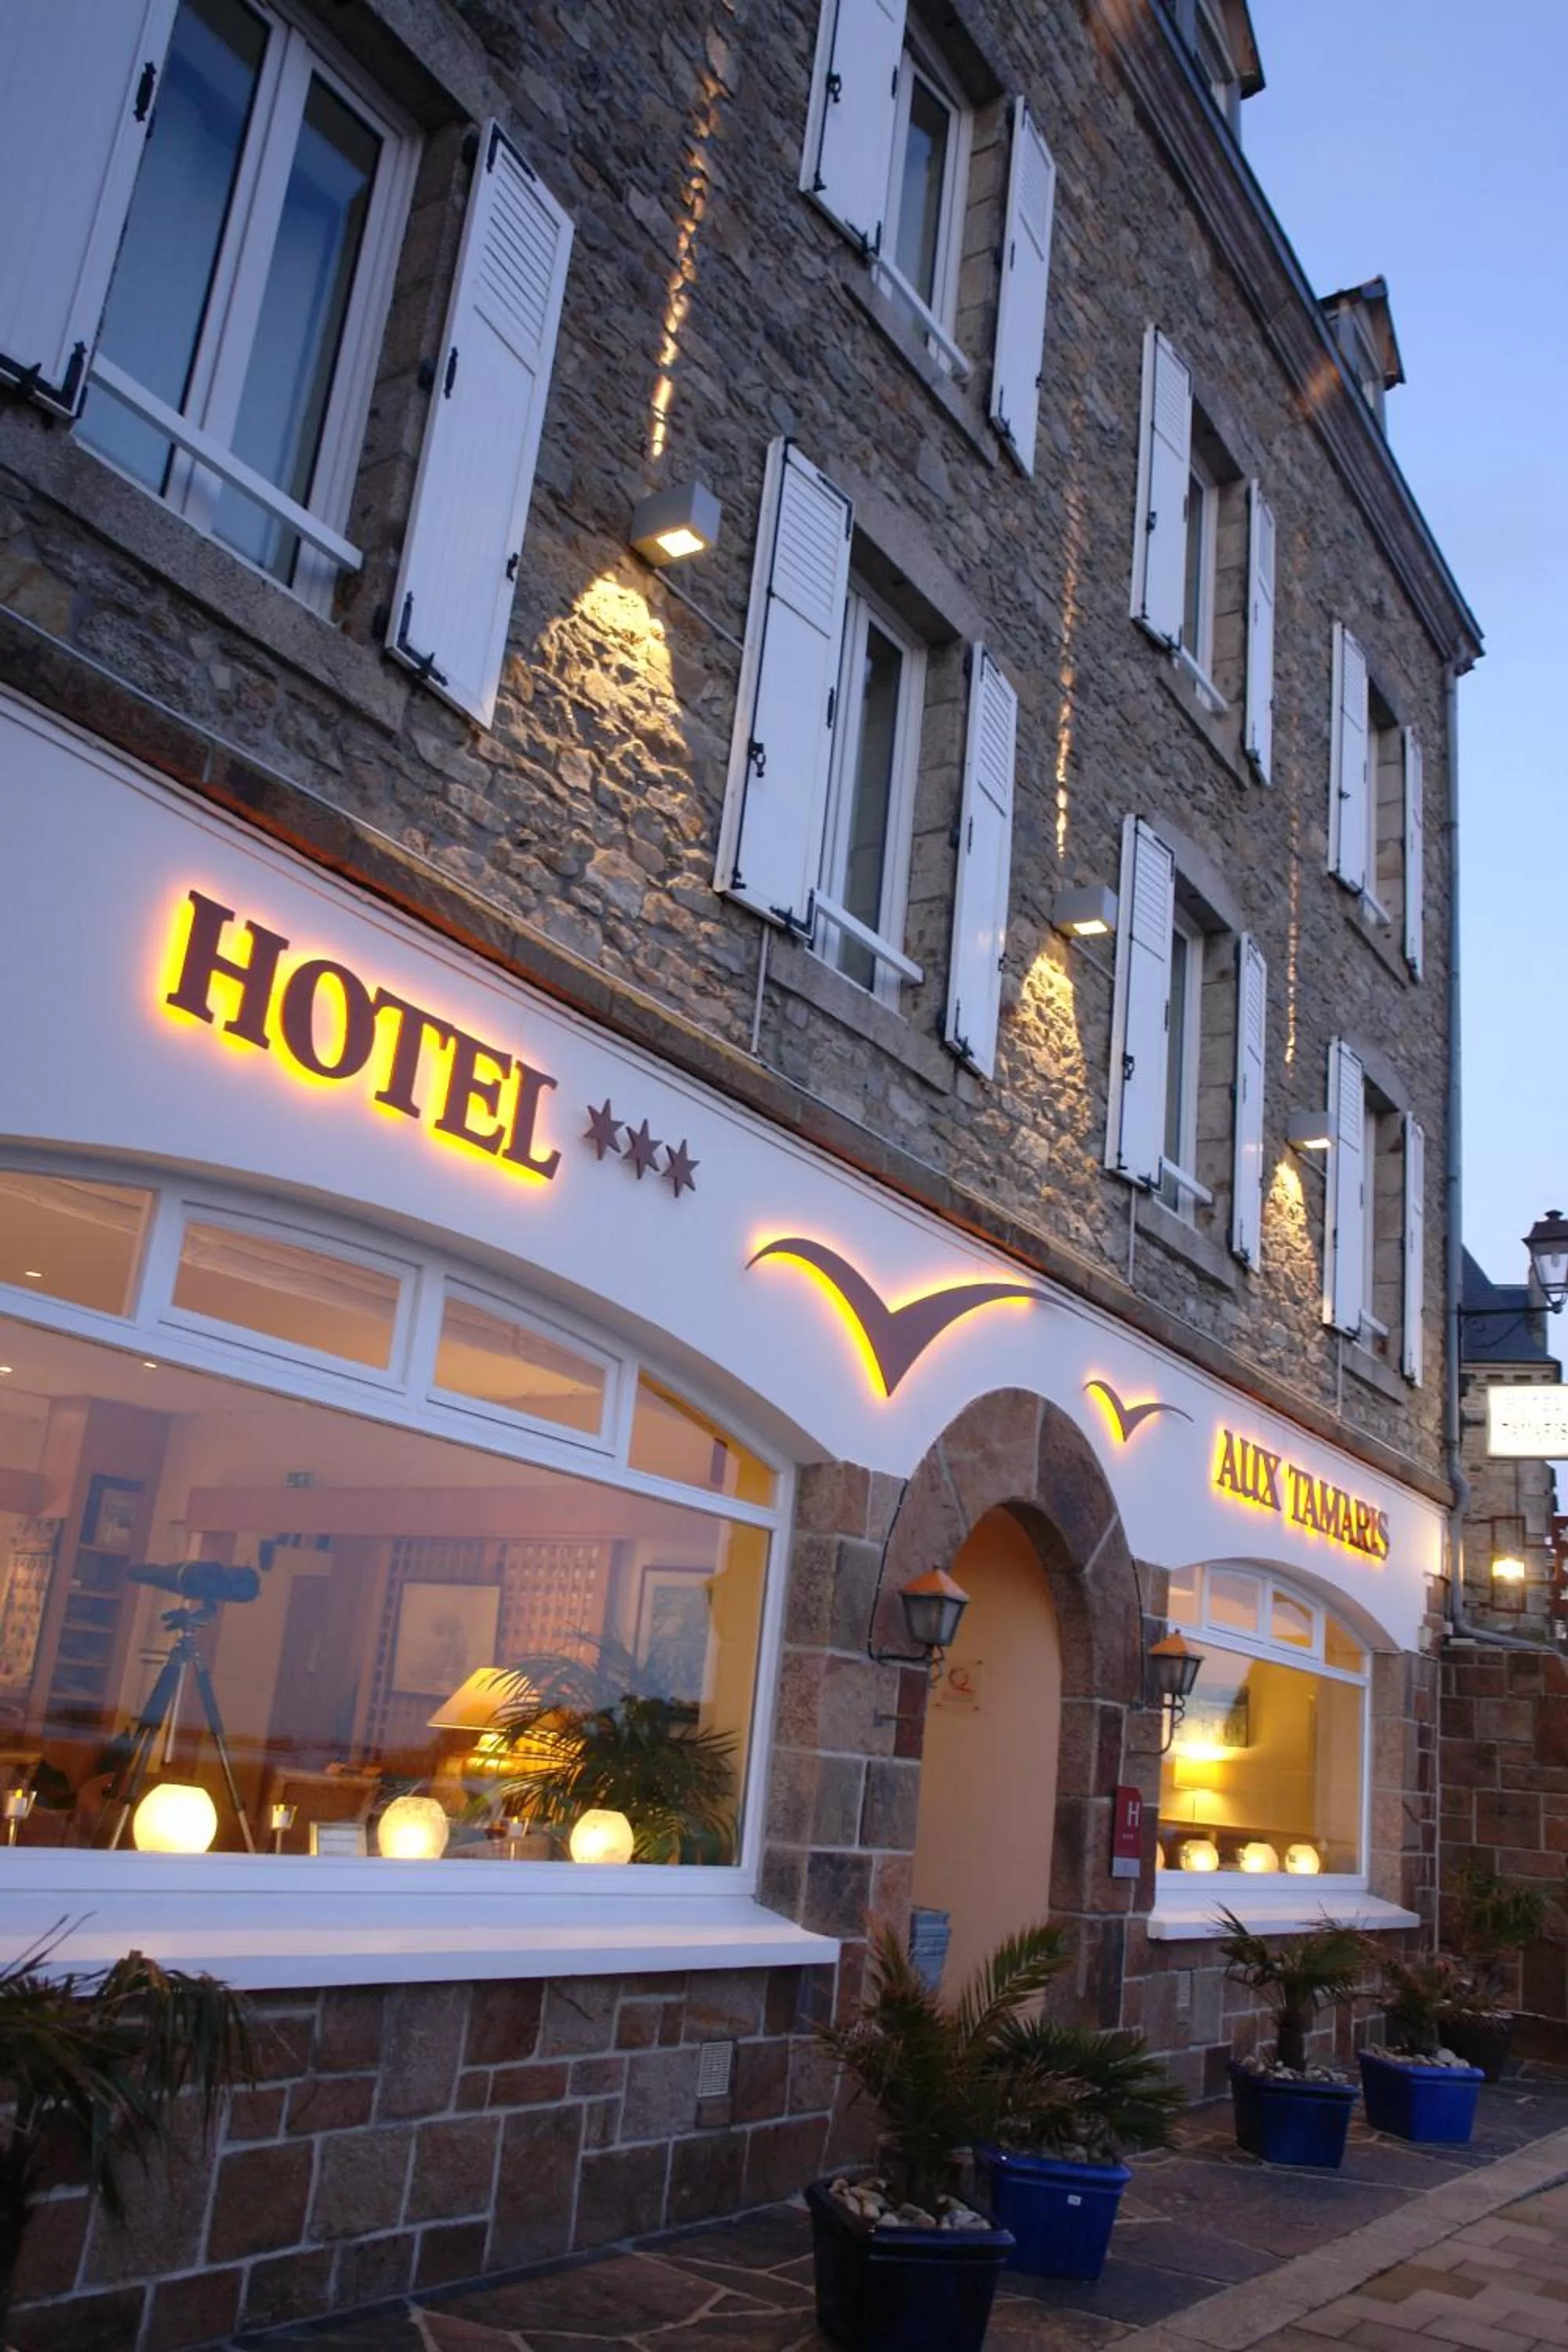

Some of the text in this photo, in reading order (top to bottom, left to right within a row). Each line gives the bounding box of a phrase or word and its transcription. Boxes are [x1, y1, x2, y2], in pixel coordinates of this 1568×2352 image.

[165, 890, 562, 1180] HOTEL
[1214, 1429, 1390, 1561] AUX TAMARIS
[1127, 1801, 1140, 1828] H
